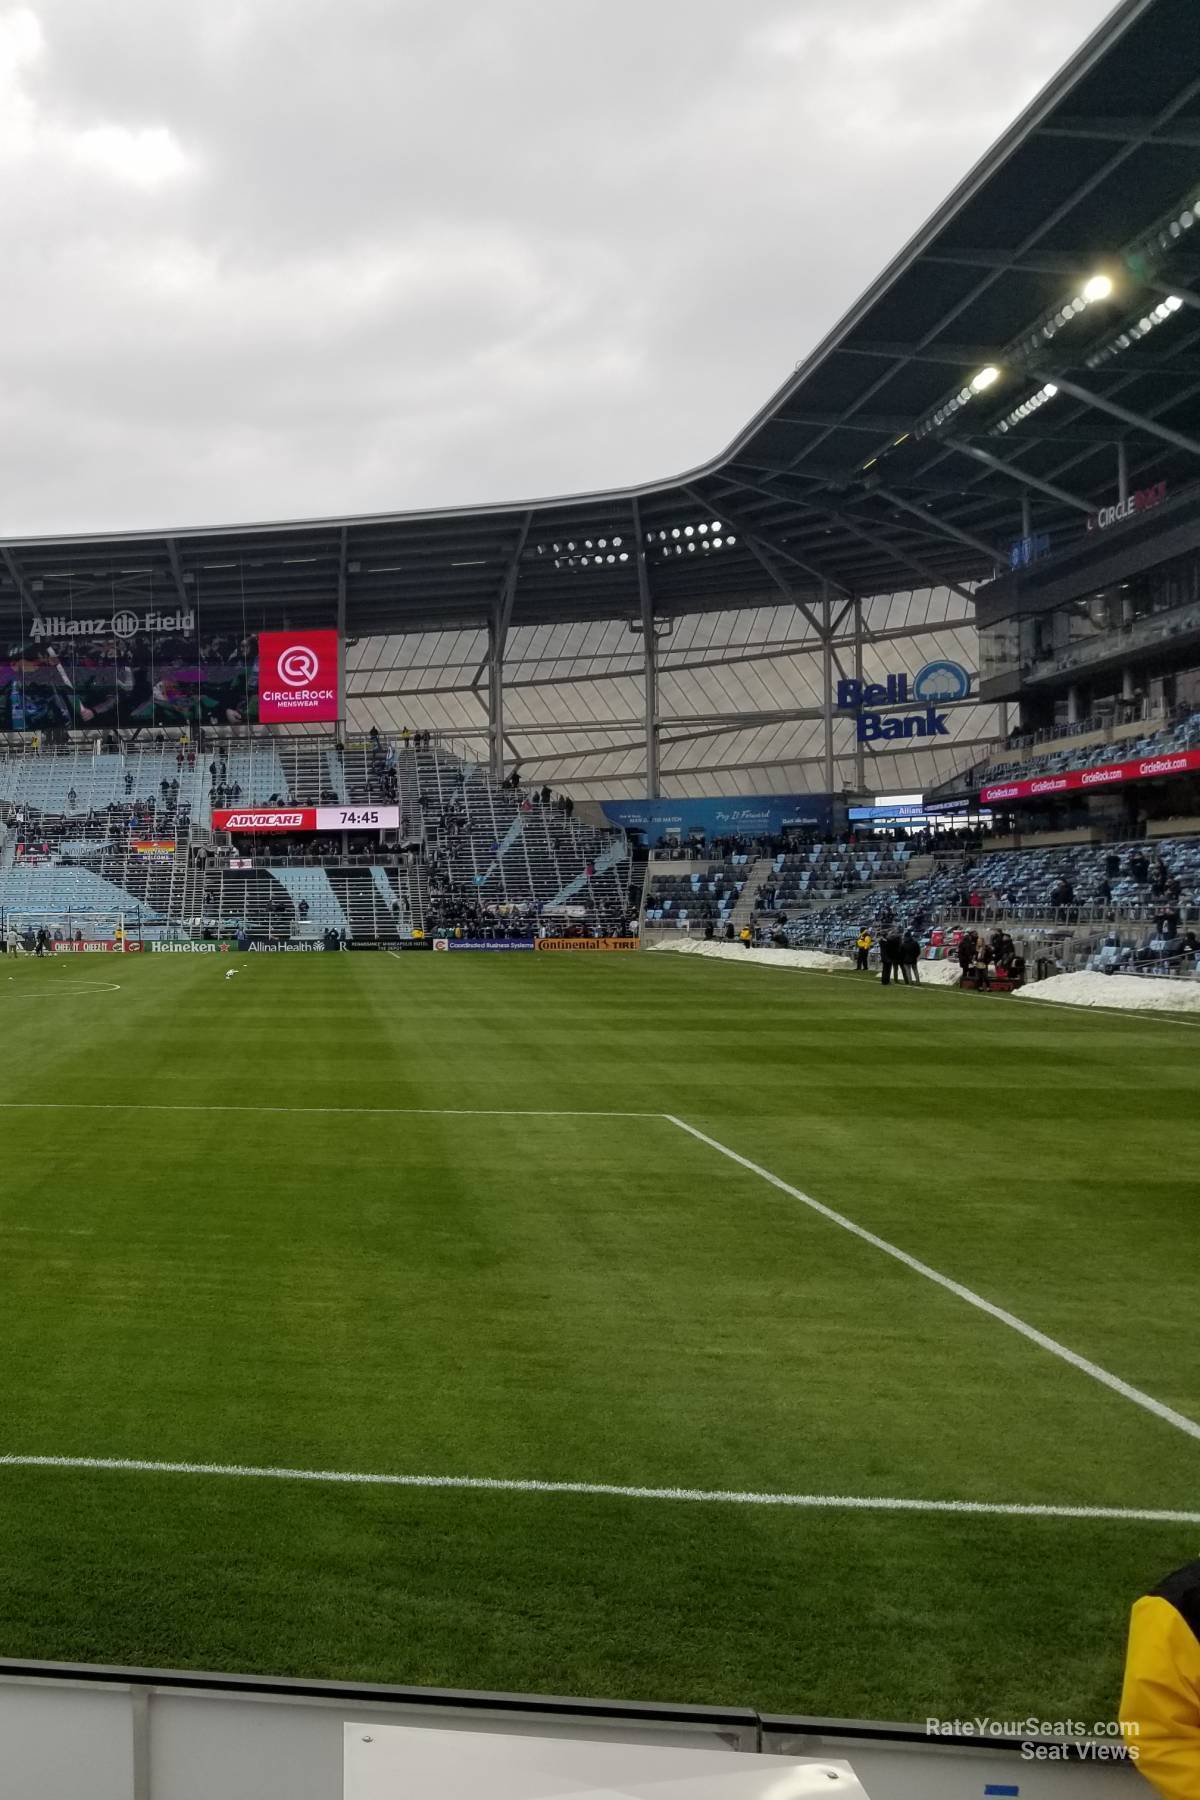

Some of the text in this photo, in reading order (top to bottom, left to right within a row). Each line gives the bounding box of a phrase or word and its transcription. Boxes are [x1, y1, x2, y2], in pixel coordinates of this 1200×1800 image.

[29, 610, 195, 637] Allianz Field
[837, 673, 907, 709] Bell
[277, 700, 319, 708] MENSWEAR
[856, 707, 951, 742] Bank
[1139, 758, 1187, 774] CircleRock.com
[1081, 769, 1122, 784] CircleRock.com
[227, 814, 302, 826] ADVOCARE
[340, 811, 379, 824] 74:45
[151, 941, 216, 955] Heineken
[339, 942, 348, 951] R
[538, 939, 600, 951] Continental
